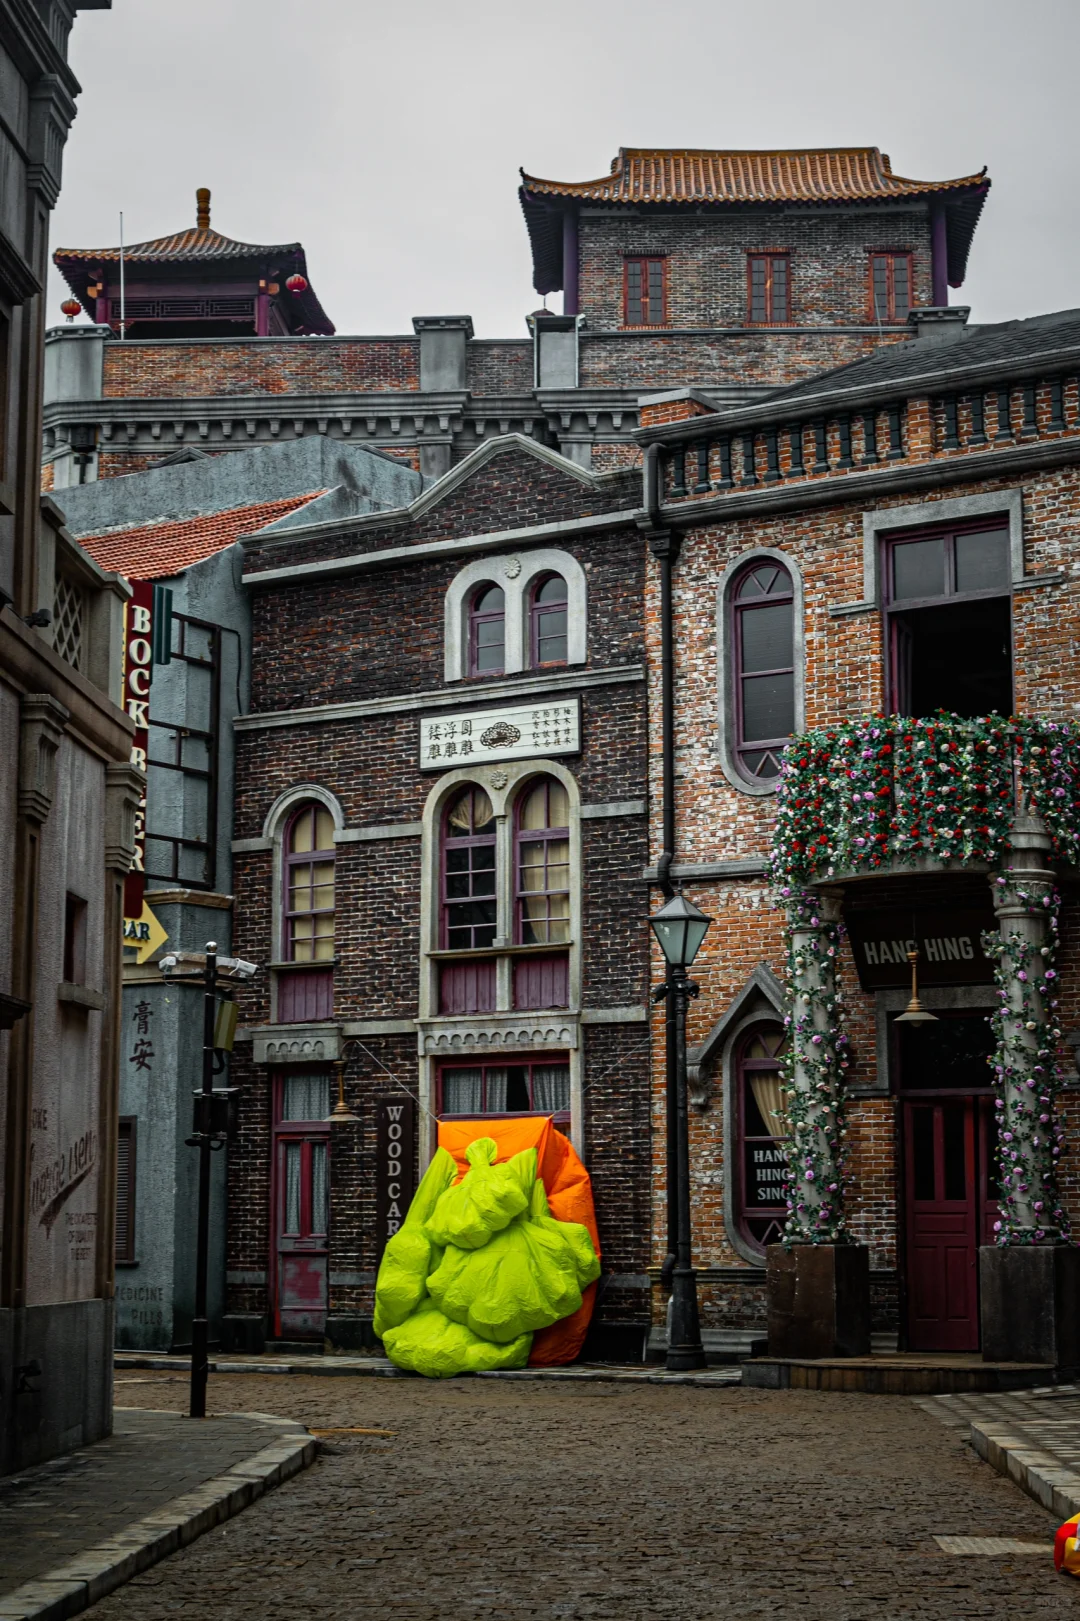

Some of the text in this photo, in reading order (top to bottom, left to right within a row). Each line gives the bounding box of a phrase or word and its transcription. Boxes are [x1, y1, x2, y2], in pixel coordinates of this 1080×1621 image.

[126, 604, 151, 872] BOCK BER
[864, 940, 919, 965] HANG
[924, 937, 974, 962] HING
[386, 1106, 404, 1240] WOOD CAR
[131, 1309, 163, 1326] PILLS
